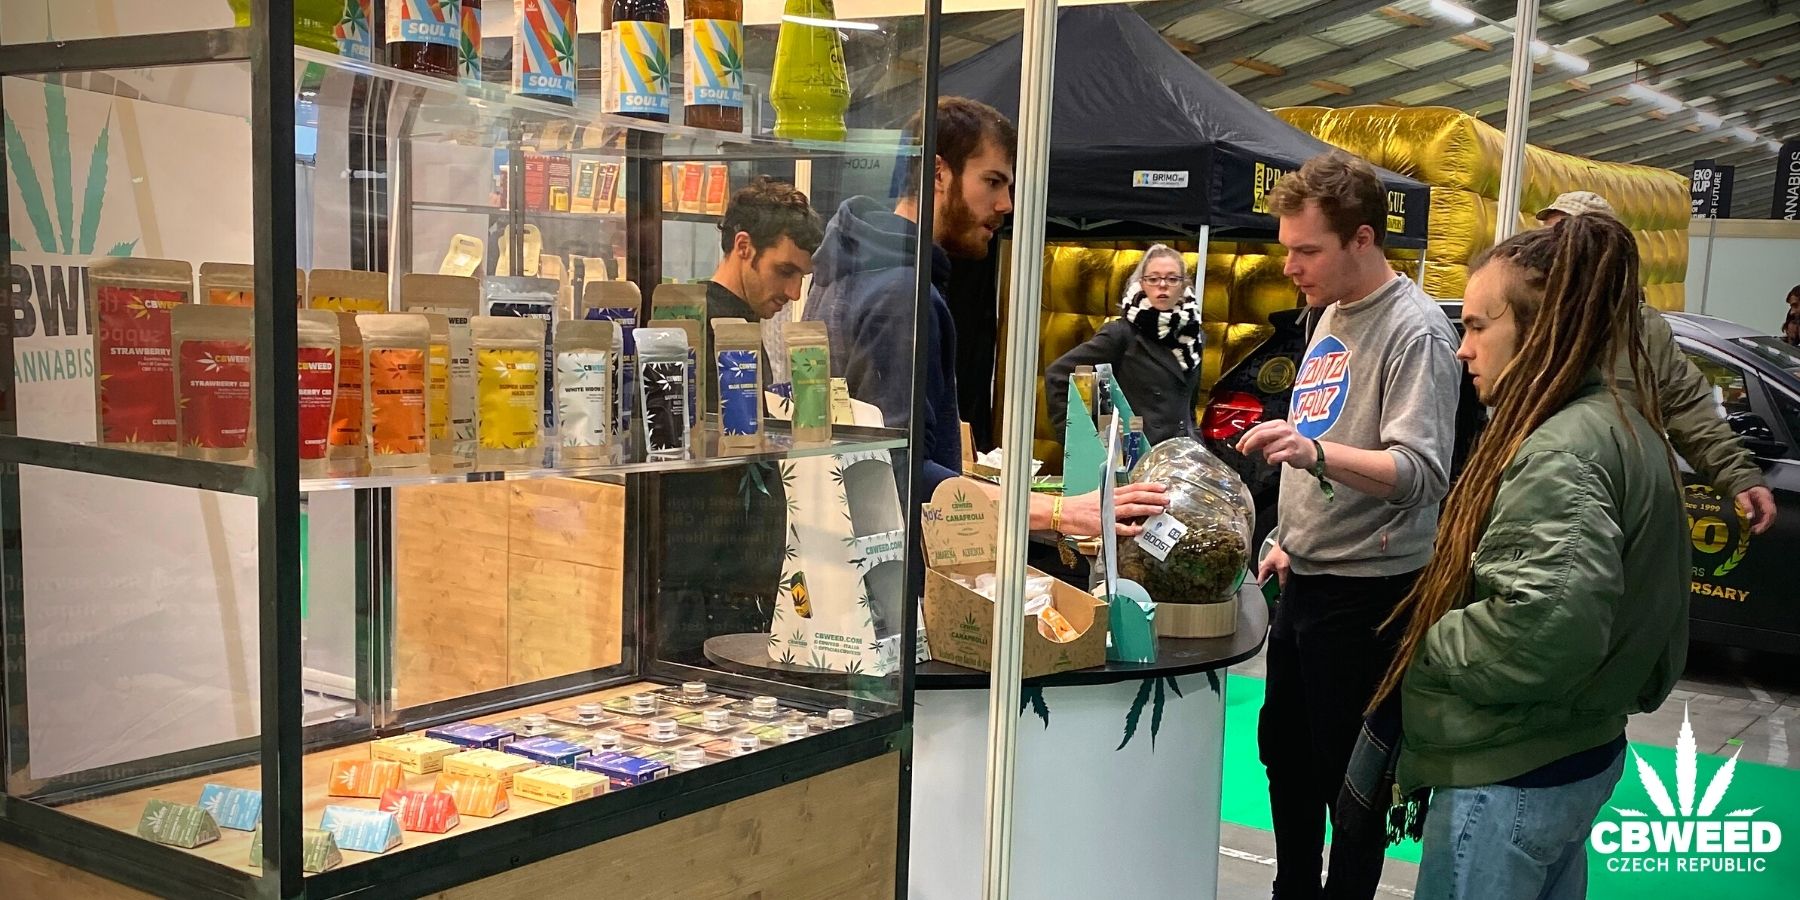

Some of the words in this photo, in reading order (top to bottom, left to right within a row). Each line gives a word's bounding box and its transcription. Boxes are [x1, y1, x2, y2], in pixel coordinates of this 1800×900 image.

[408, 22, 445, 36] SOUL
[529, 75, 562, 89] SOUL
[625, 95, 658, 106] SOUL
[699, 88, 730, 100] SOUL
[1152, 173, 1178, 181] BRIMO
[1693, 168, 1712, 181] EKO
[1692, 180, 1711, 192] KUP
[1711, 171, 1722, 206] FUTURE
[110, 347, 171, 355] STRAWBERRY
[1687, 516, 1729, 553] 0
[866, 541, 903, 555] CBWEED.COM
[1143, 531, 1170, 552] BOOST
[1691, 581, 1750, 602] RSARY
[815, 632, 863, 644] CBWEED.COM
